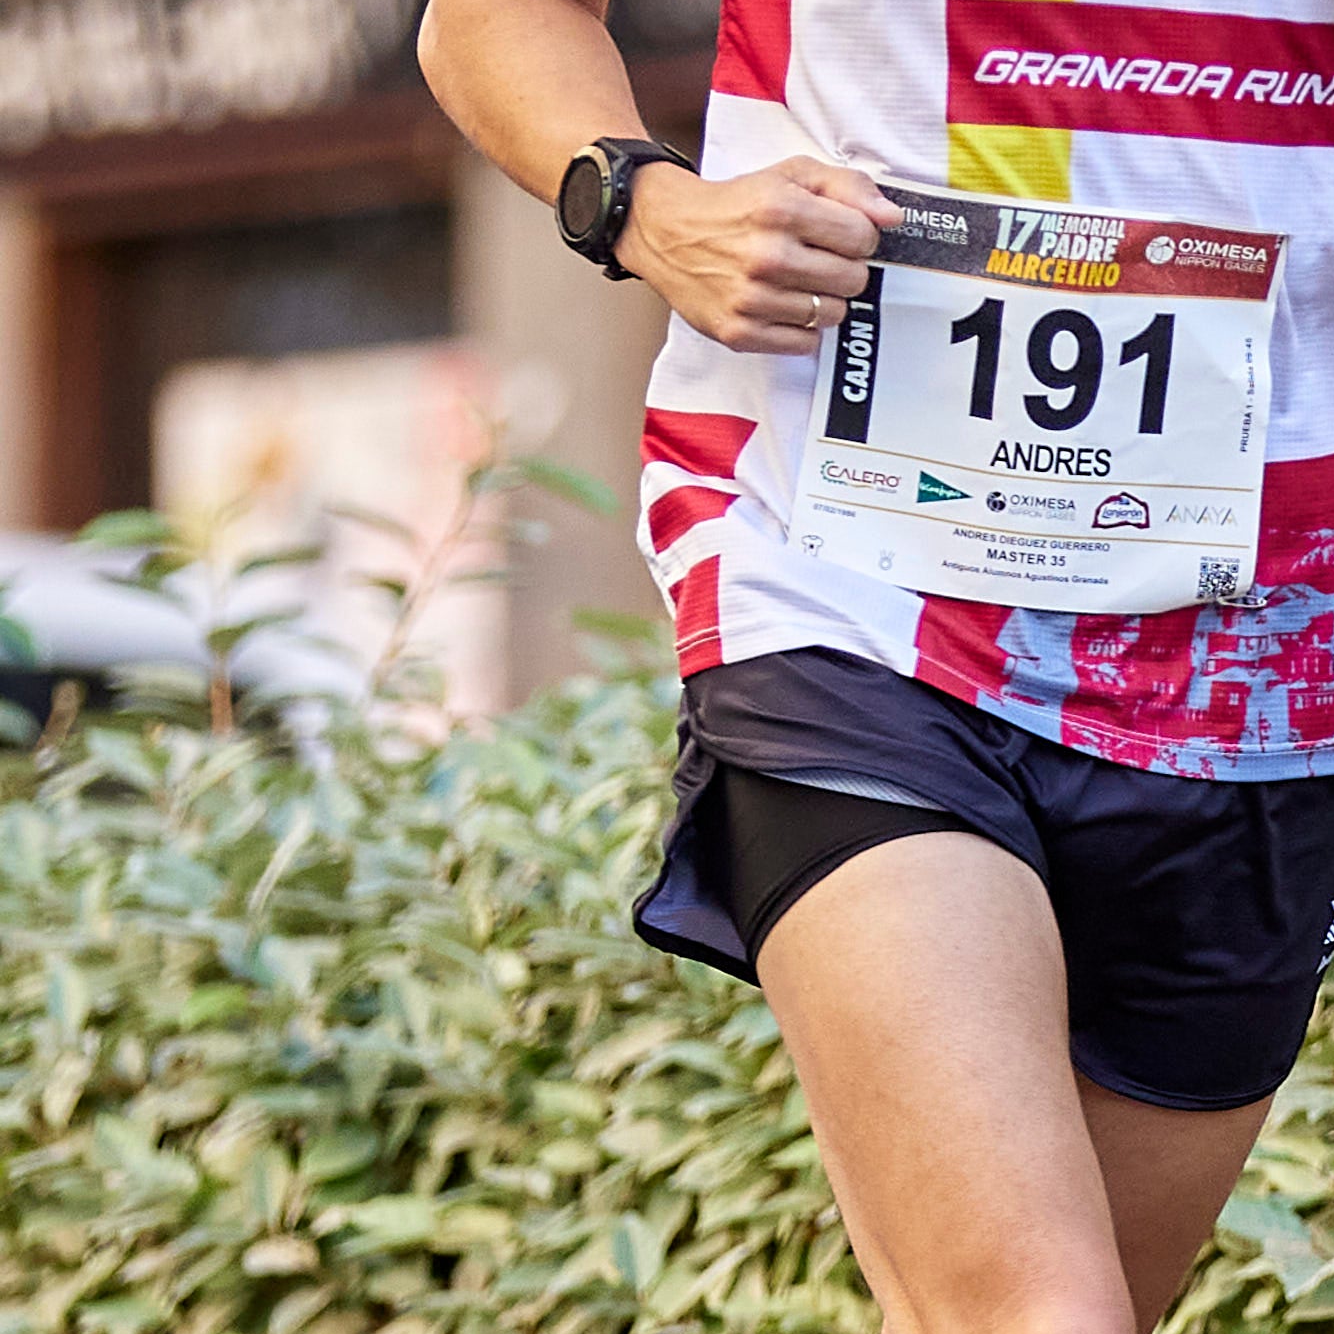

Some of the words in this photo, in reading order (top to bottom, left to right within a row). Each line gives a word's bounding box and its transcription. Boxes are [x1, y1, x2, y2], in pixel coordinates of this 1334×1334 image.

[974, 49, 1234, 100] GRANADA
[900, 207, 969, 233] IMESA
[995, 208, 1043, 252] 17
[1040, 213, 1125, 239] MEMORIAL
[1038, 232, 1119, 263] PADRE
[1178, 237, 1268, 263] OXIMESA
[984, 248, 1121, 288] MARCELINO
[1174, 255, 1221, 269] NIPPON
[1224, 259, 1266, 275] GASES
[850, 300, 874, 311] 1
[842, 320, 874, 403] CAJÓN
[950, 296, 1176, 436] 191
[990, 440, 1112, 477] ANDRES
[826, 464, 900, 488] CALERO
[1009, 493, 1077, 511] OXIMESA
[1165, 504, 1239, 527] ANAYA
[952, 527, 996, 543] ANDRES
[999, 534, 1047, 549] DIEGUEZ
[1049, 540, 1111, 553] GUERRERO
[986, 548, 1047, 566] MASTER
[1049, 555, 1067, 567] 35
